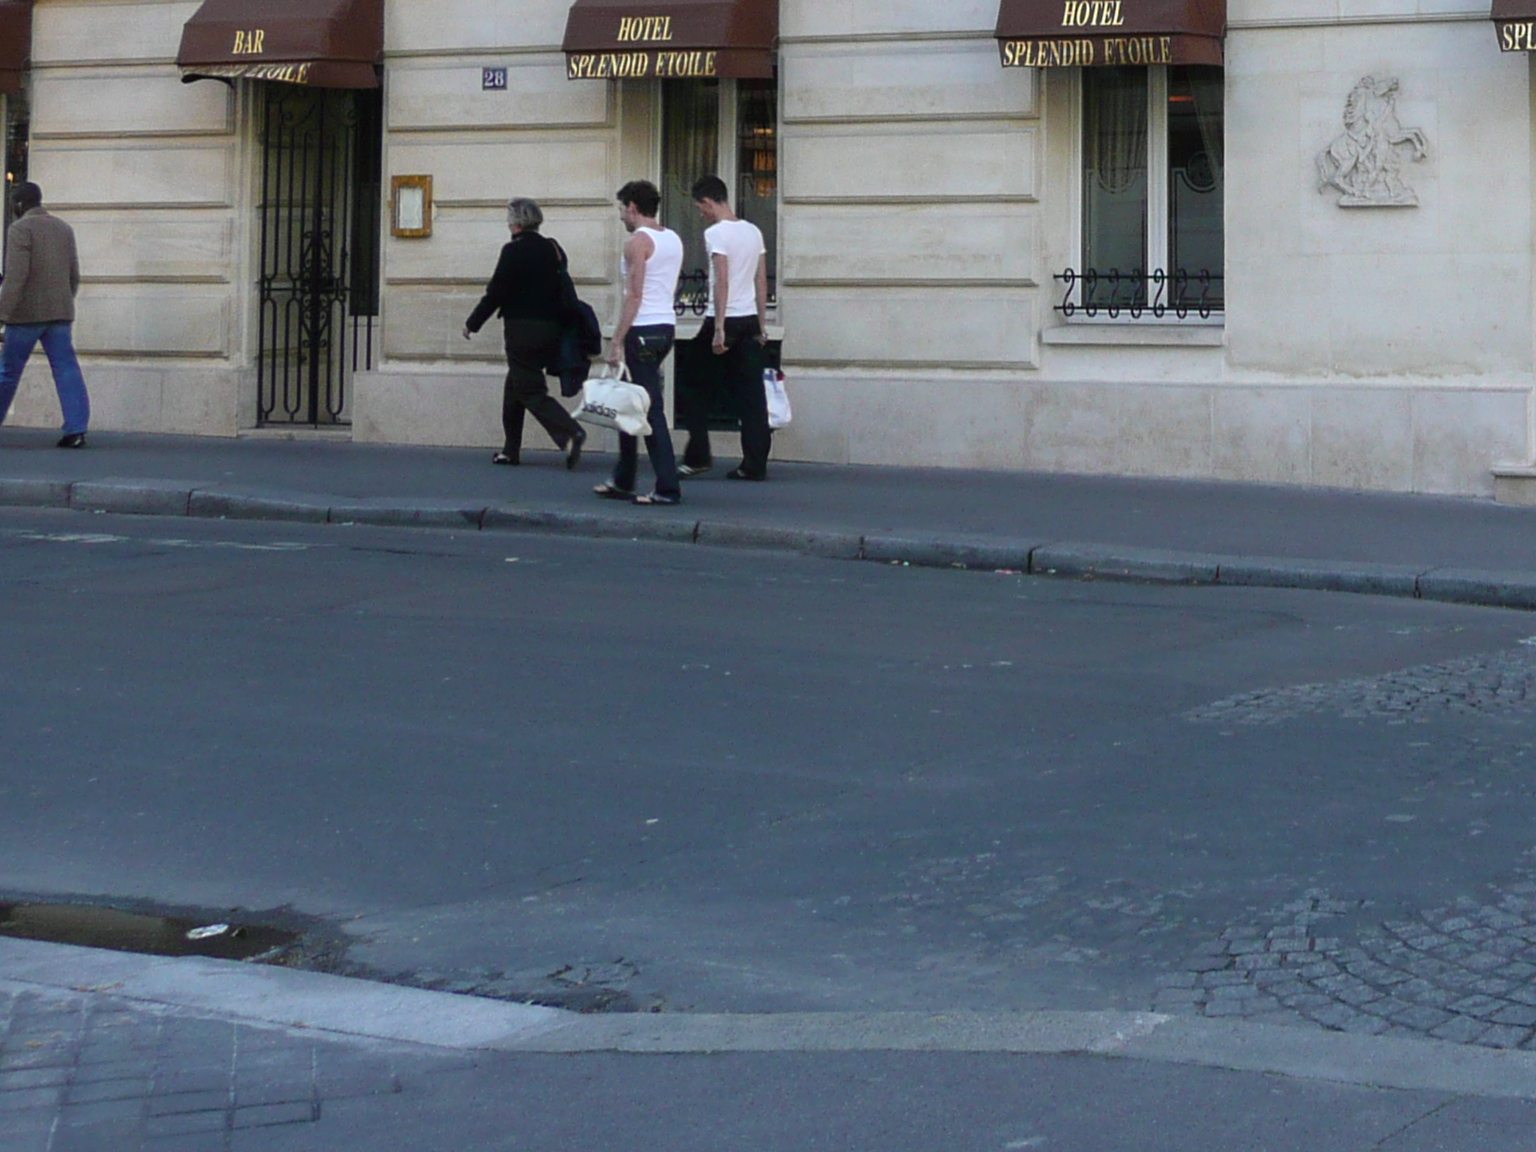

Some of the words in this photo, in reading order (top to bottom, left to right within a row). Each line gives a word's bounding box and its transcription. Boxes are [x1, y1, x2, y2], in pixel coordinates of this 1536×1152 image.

[1061, 0, 1125, 26] HOTEL
[617, 16, 673, 41] HOTEL
[232, 29, 264, 54] BAR
[1003, 39, 1095, 66] SPLENDID
[1103, 36, 1172, 65] ETOILE
[569, 52, 648, 78] SPLENDID
[655, 51, 717, 76] ETOILE
[483, 71, 505, 87] 28
